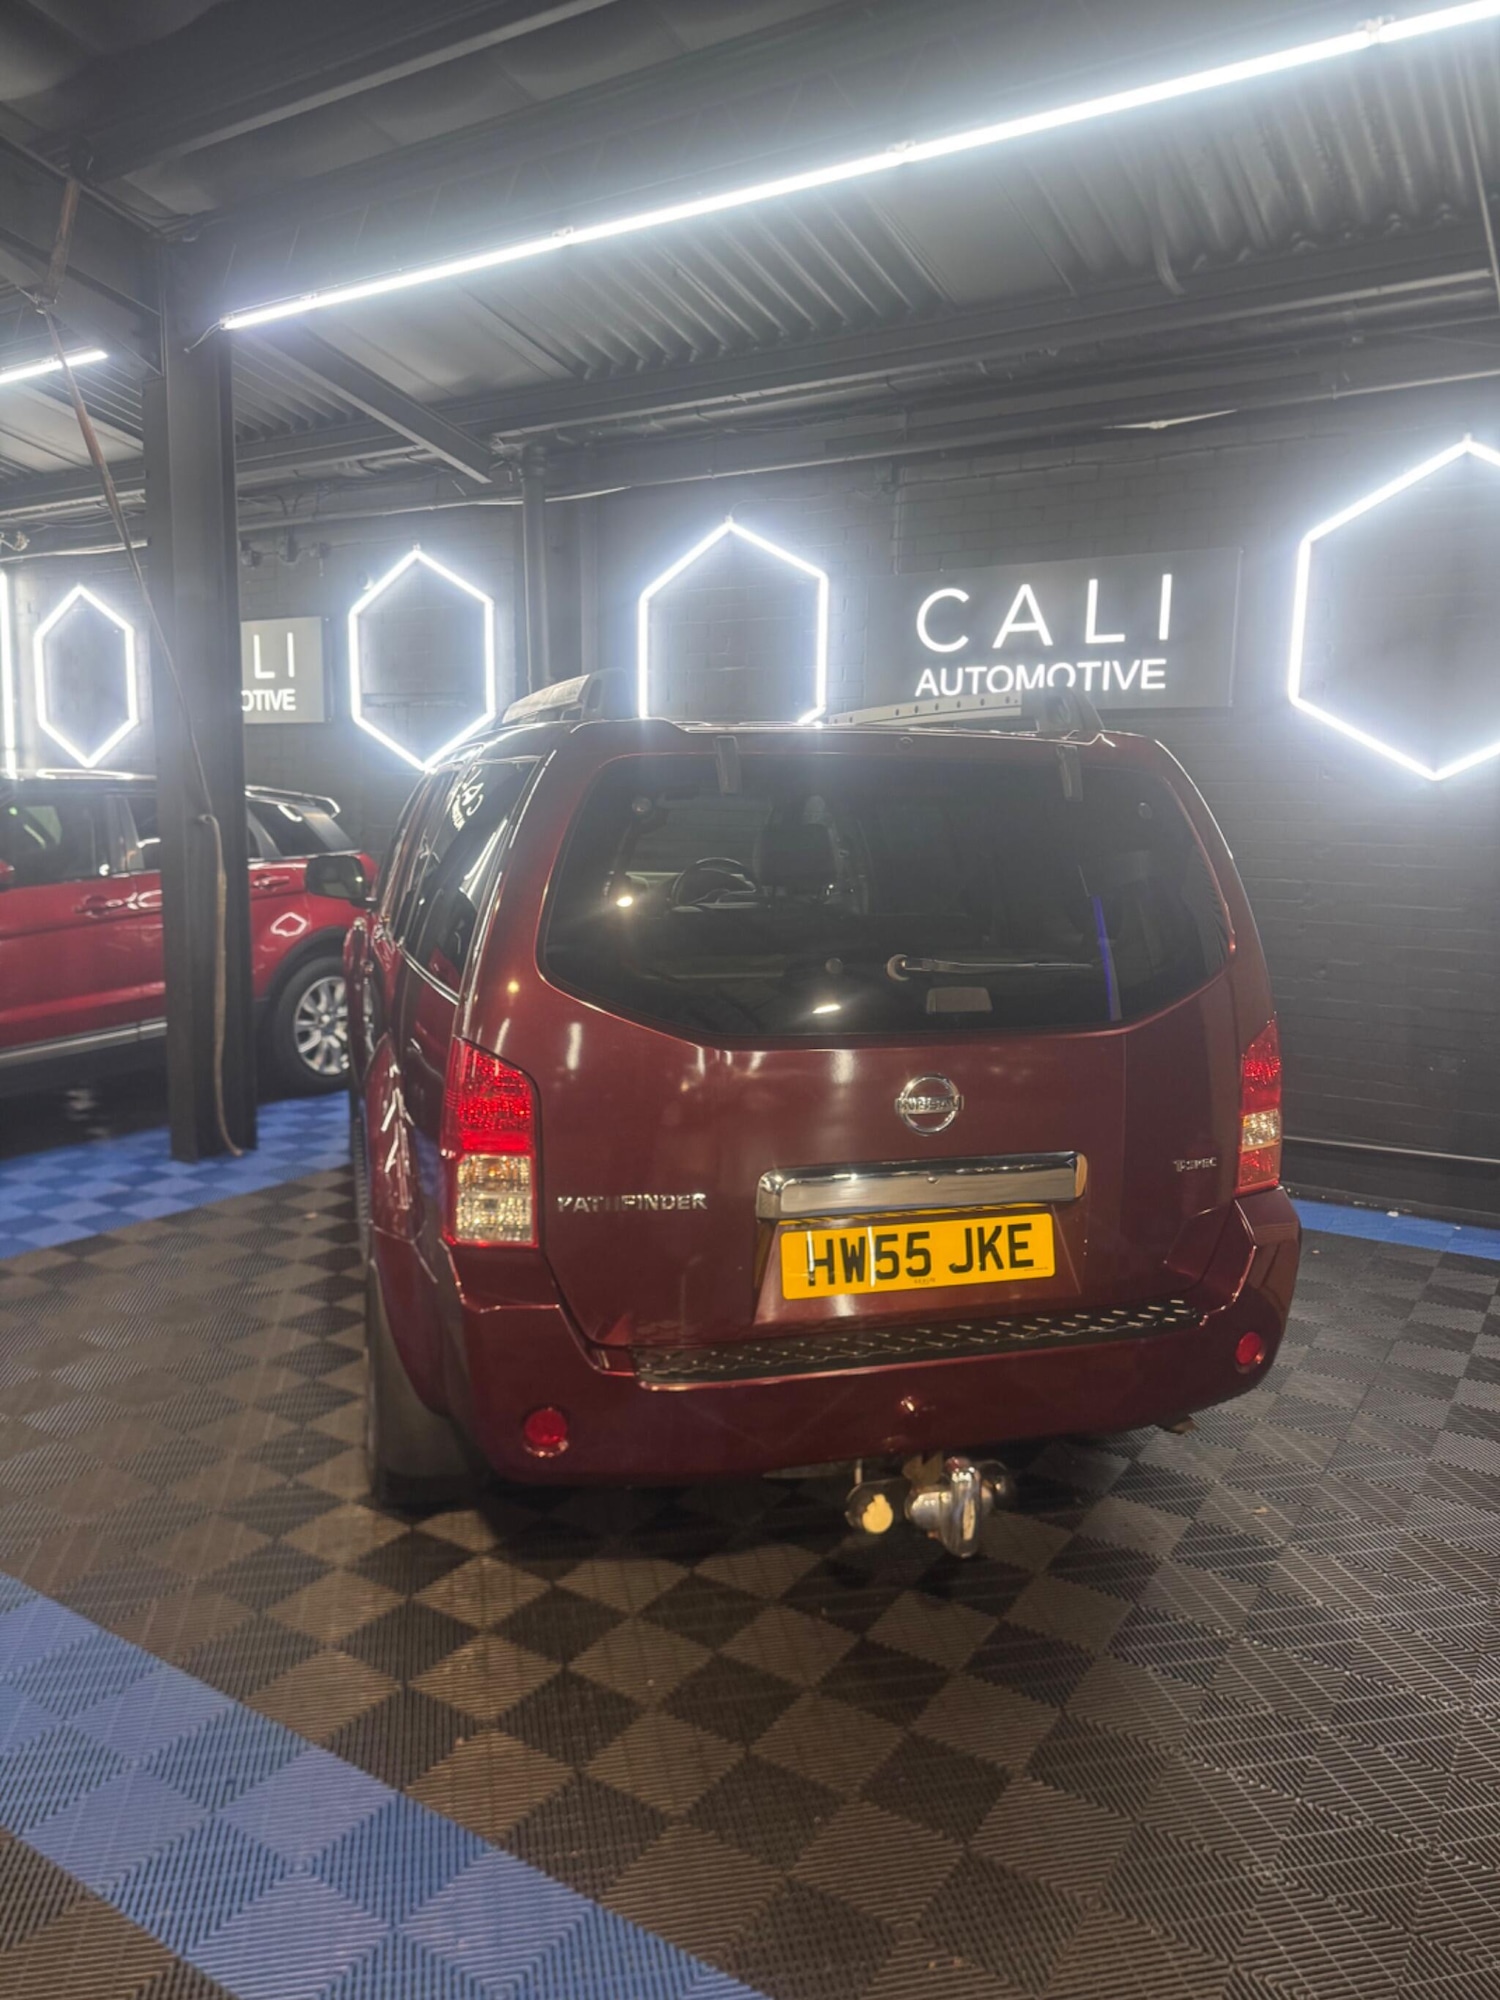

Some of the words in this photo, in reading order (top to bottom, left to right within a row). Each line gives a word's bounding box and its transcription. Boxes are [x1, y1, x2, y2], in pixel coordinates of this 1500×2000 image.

[916, 573, 1172, 653] CALI
[253, 632, 295, 679] LI
[915, 658, 1167, 697] AUTOMOTIVE
[241, 688, 297, 712] OTIVE
[557, 1192, 709, 1214] PATHFINDER
[806, 1231, 932, 1287] HW55
[948, 1223, 1035, 1274] JKE
